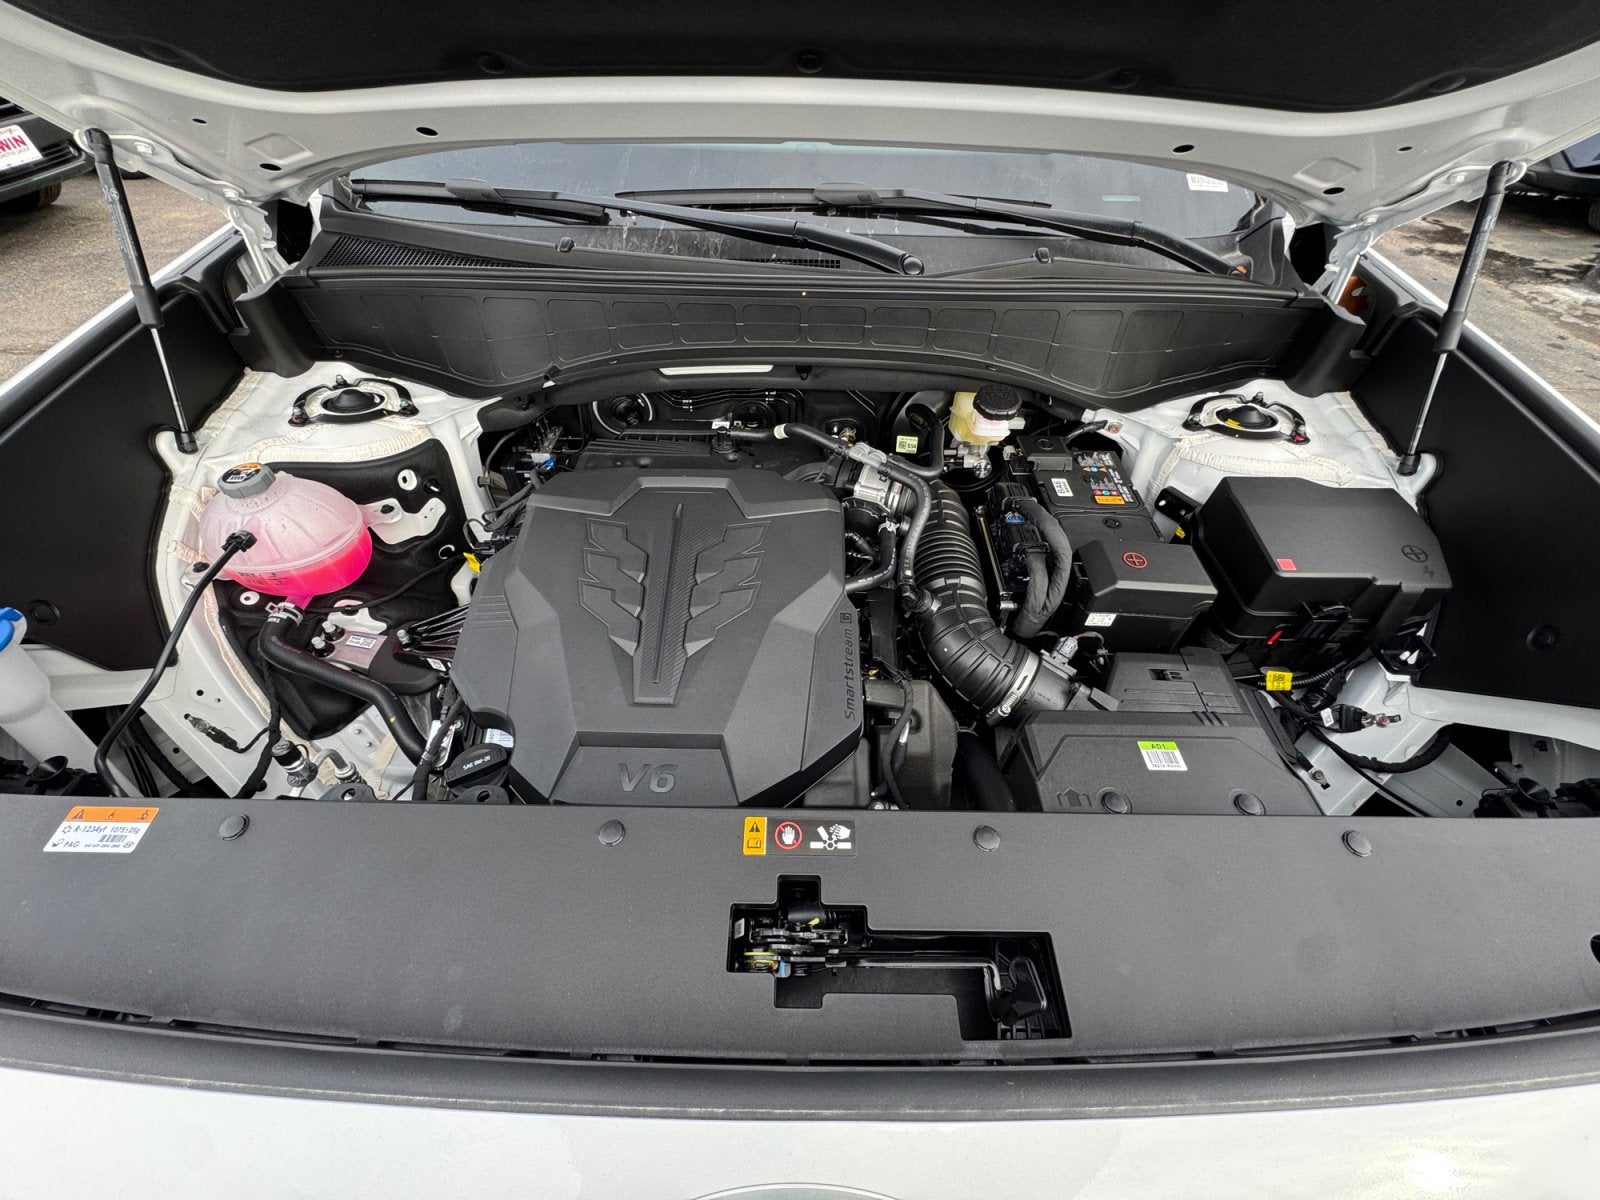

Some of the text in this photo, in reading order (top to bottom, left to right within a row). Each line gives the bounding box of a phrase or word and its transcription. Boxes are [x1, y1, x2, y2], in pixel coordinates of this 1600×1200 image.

[843, 628, 856, 721] Smartstream
[462, 761, 474, 771] SAE
[618, 762, 678, 793] V6
[73, 825, 108, 834] R-1234yf
